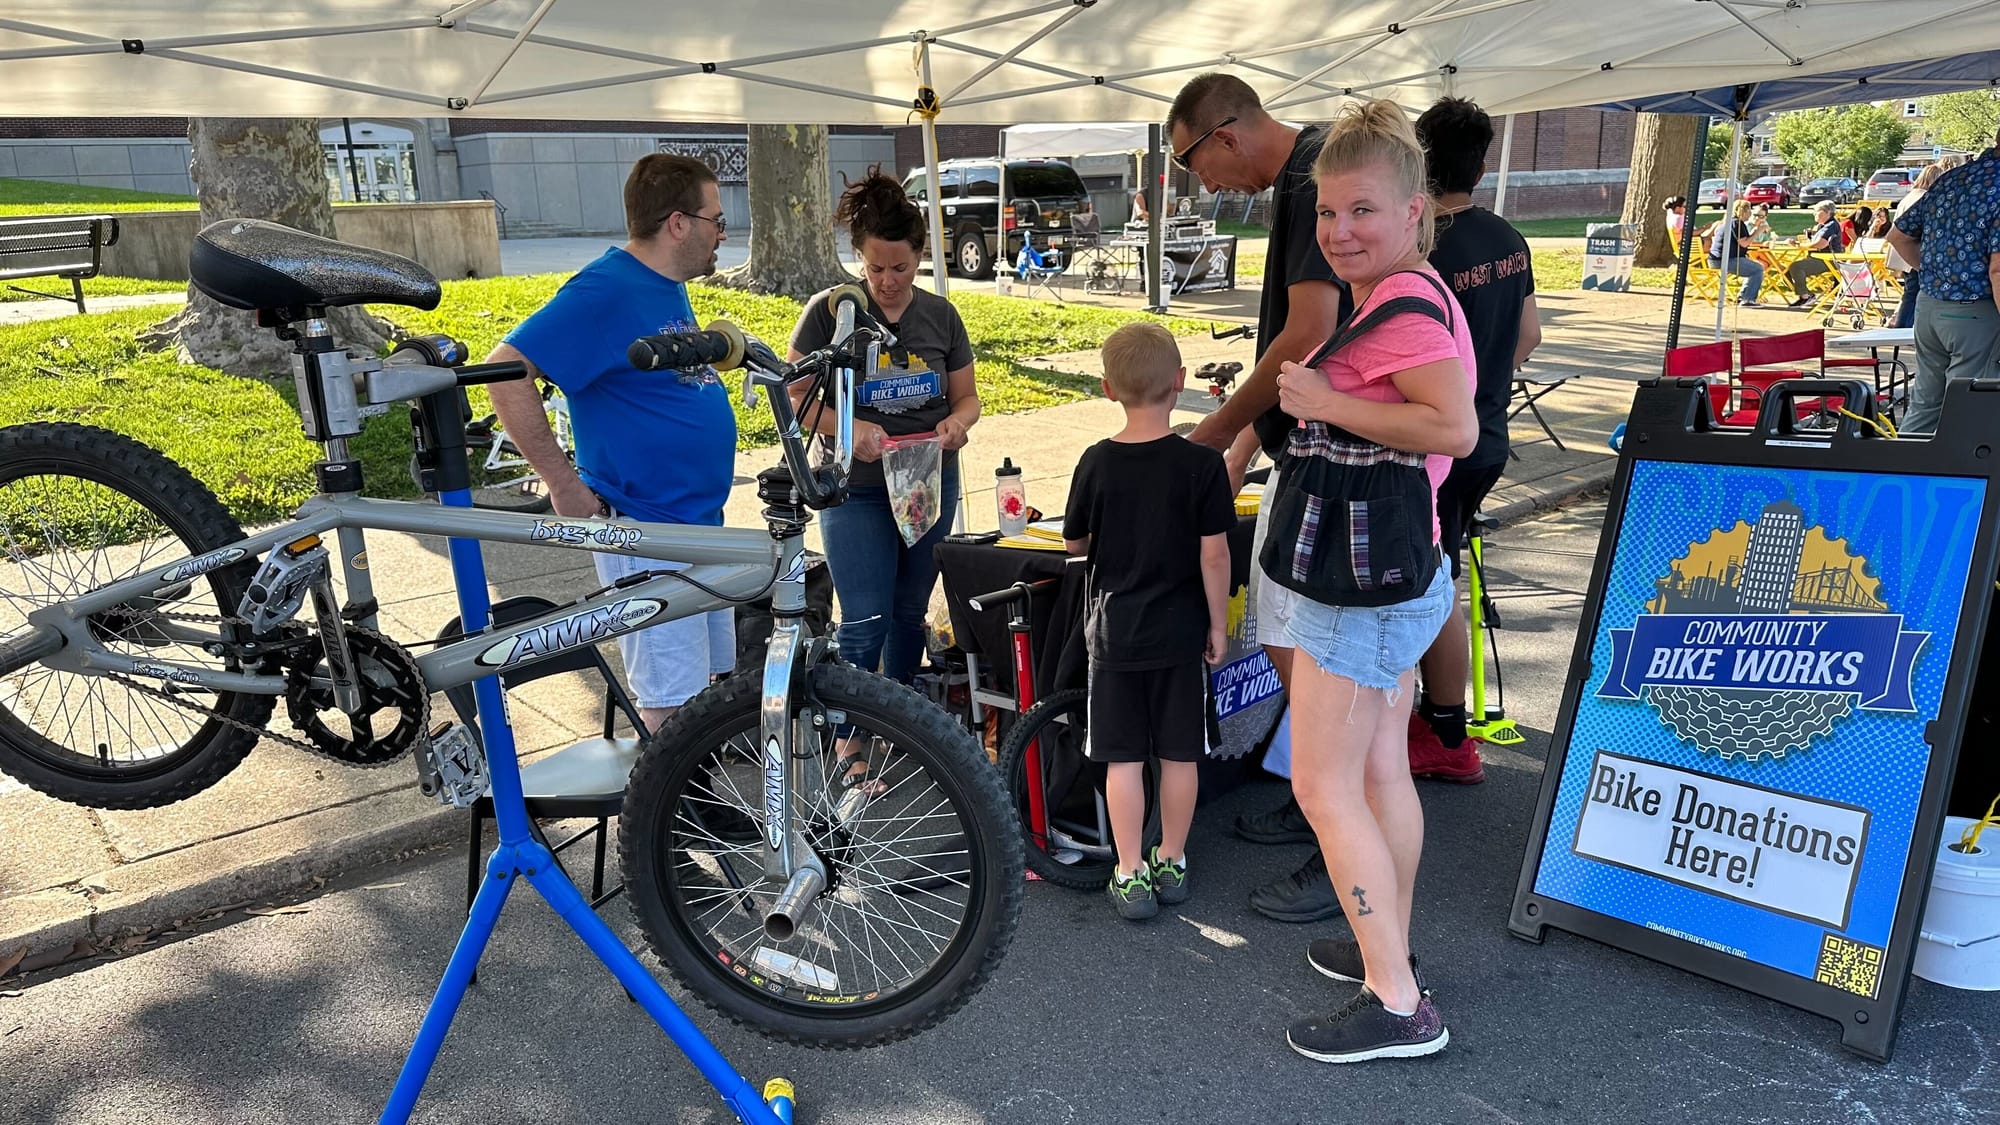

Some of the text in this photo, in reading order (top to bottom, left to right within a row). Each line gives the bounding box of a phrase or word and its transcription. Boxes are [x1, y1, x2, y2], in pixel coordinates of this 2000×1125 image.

[1591, 239, 1616, 247] TRASH
[1454, 263, 1492, 292] WEST
[871, 382, 932, 401] BIKE WORKS
[880, 376, 920, 389] COMMUNITY
[531, 519, 644, 551] big dip
[174, 549, 231, 581] AMX
[502, 598, 656, 667] AMX xtreme
[1682, 620, 1829, 646] COMMUNITY
[1217, 651, 1273, 692] COMMUNI
[1645, 647, 1864, 686] BIKE WORKS
[1214, 668, 1282, 716] KE WOR
[764, 745, 784, 834] AMX
[1591, 764, 1857, 866] Bike Donations
[1663, 825, 1762, 889] Here!
[1645, 920, 1748, 959] COMMUNITYBIKEWORKSORG
